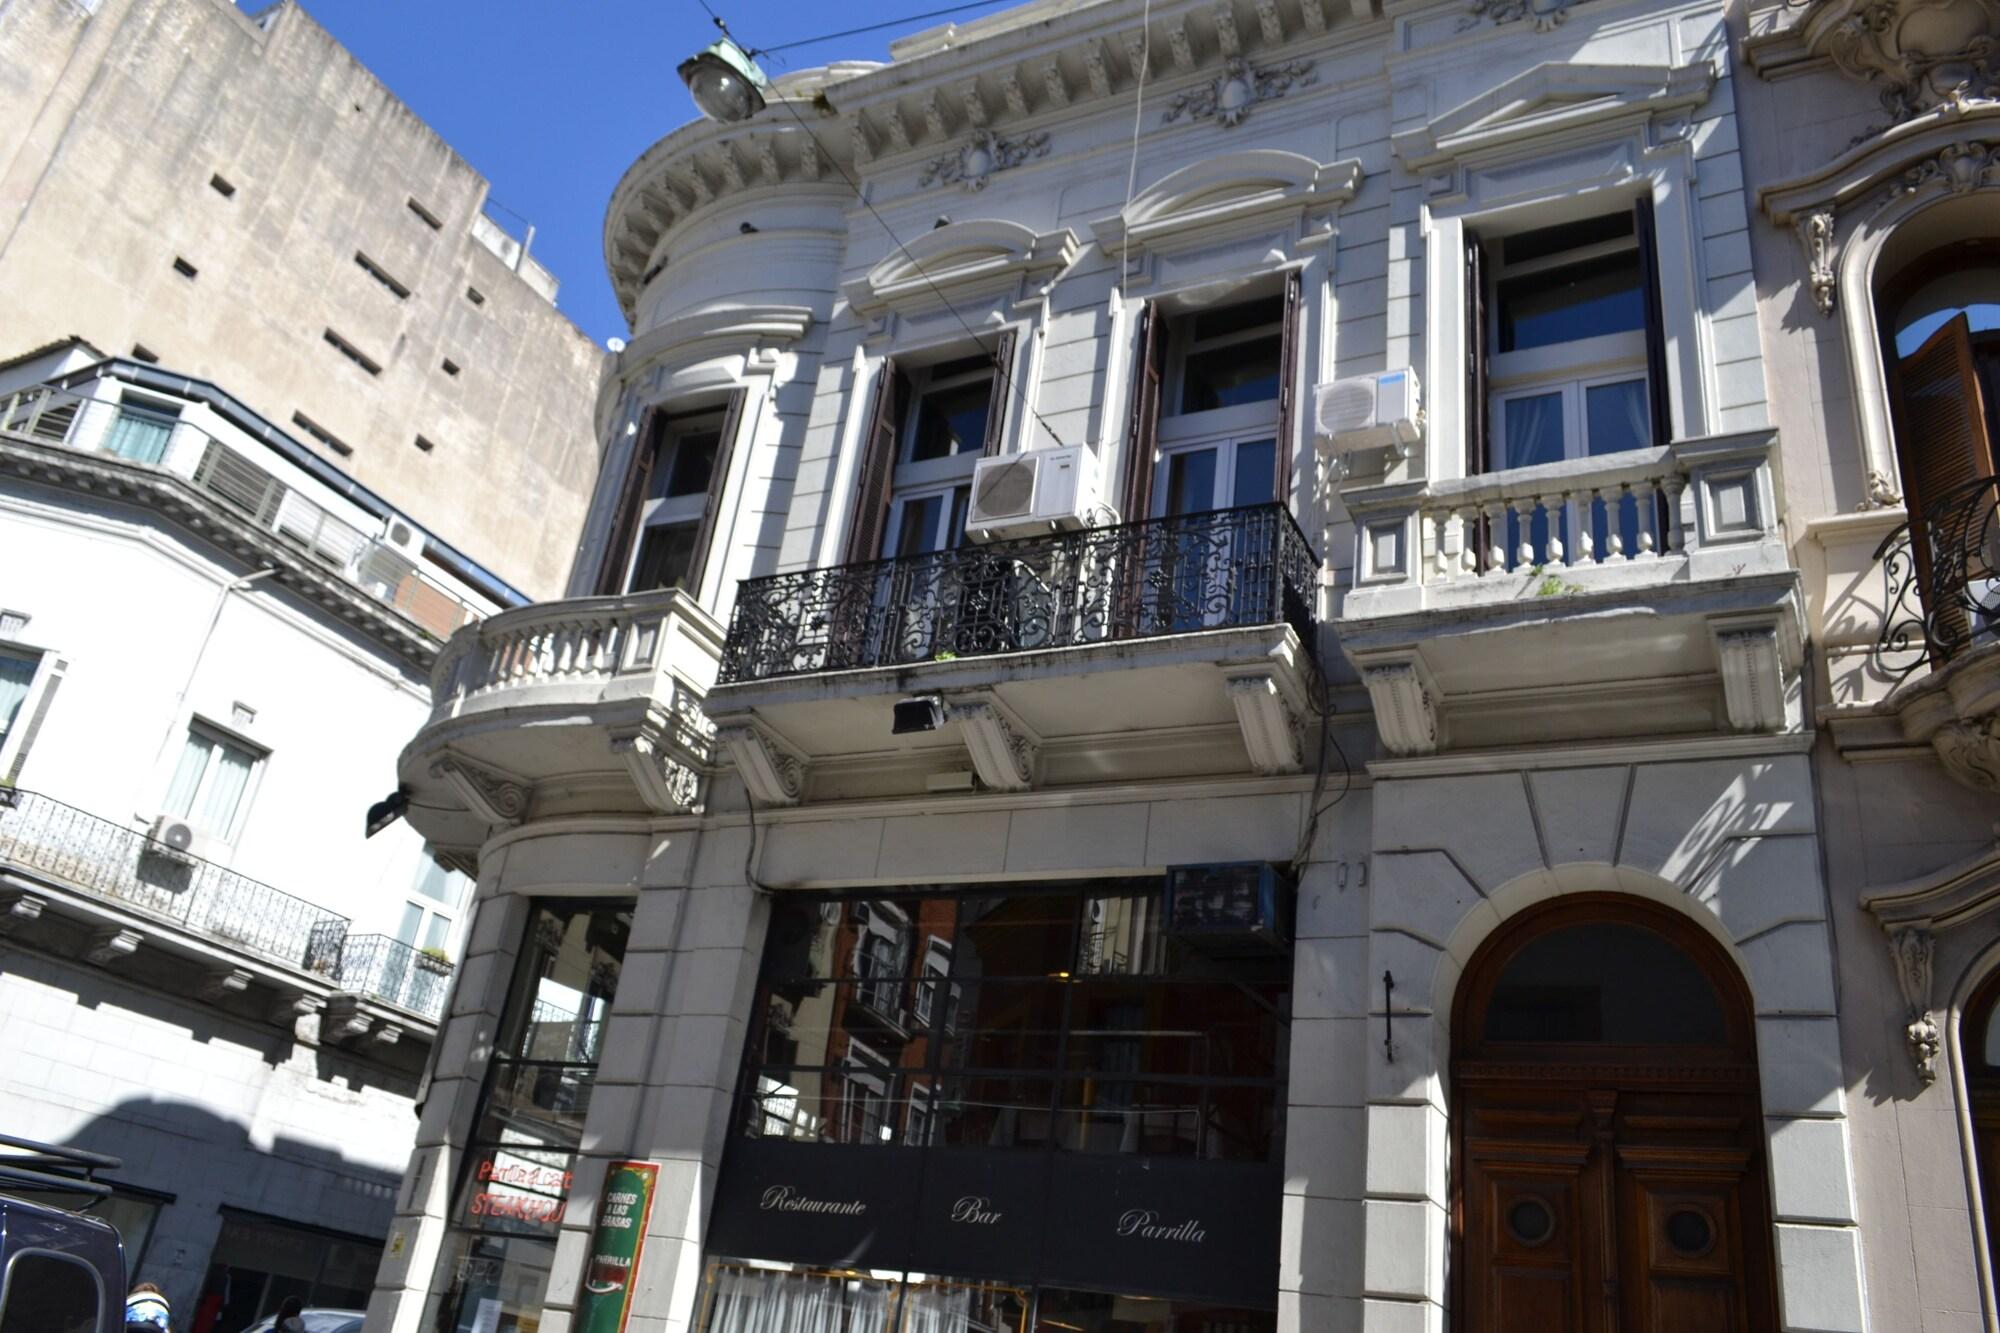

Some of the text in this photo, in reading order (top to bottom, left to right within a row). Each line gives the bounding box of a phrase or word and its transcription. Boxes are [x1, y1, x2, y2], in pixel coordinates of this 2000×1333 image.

[607, 1192, 638, 1205] CARNES
[760, 1185, 867, 1216] Restaurante
[612, 1204, 629, 1216] LAS
[951, 1195, 1002, 1224] Bar
[1117, 1210, 1207, 1242] Parrilla
[594, 1254, 631, 1267] PARRILLA
